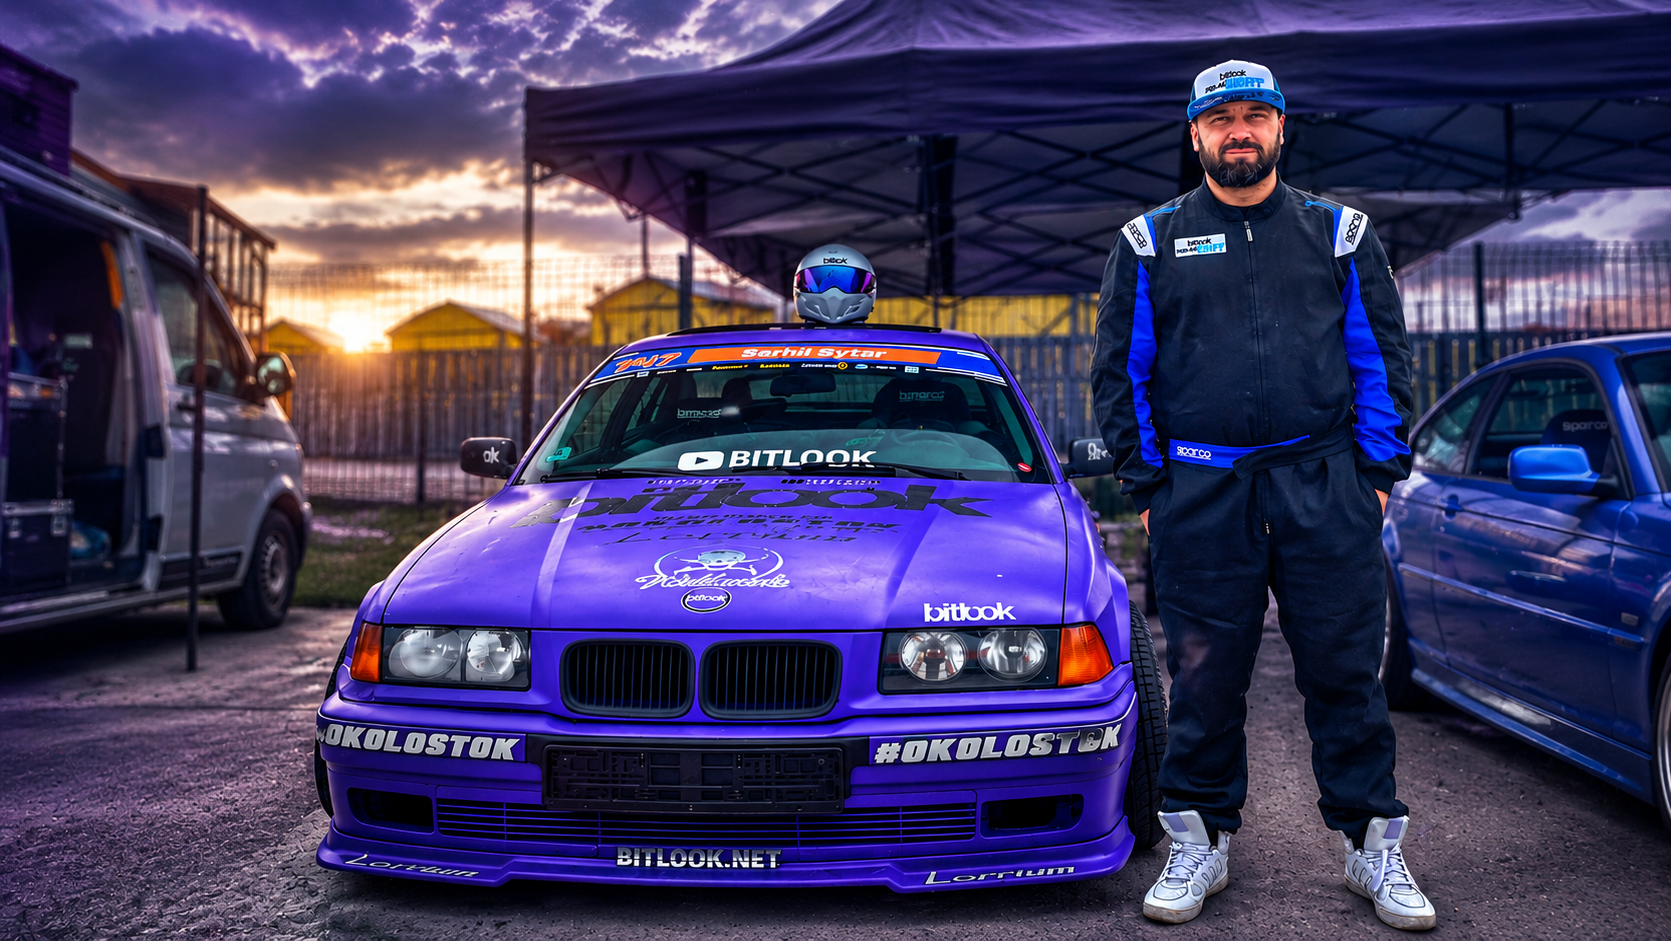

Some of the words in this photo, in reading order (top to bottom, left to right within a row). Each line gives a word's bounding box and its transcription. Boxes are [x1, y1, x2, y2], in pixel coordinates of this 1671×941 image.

[1562, 421, 1608, 432] sparco
[729, 450, 877, 468] BITLOOK
[924, 602, 1016, 622] bitlook
[874, 724, 1121, 763] #OKOLOSTOK
[617, 847, 781, 868] BITLOOK.NET
[925, 867, 1075, 884] Lorrium
